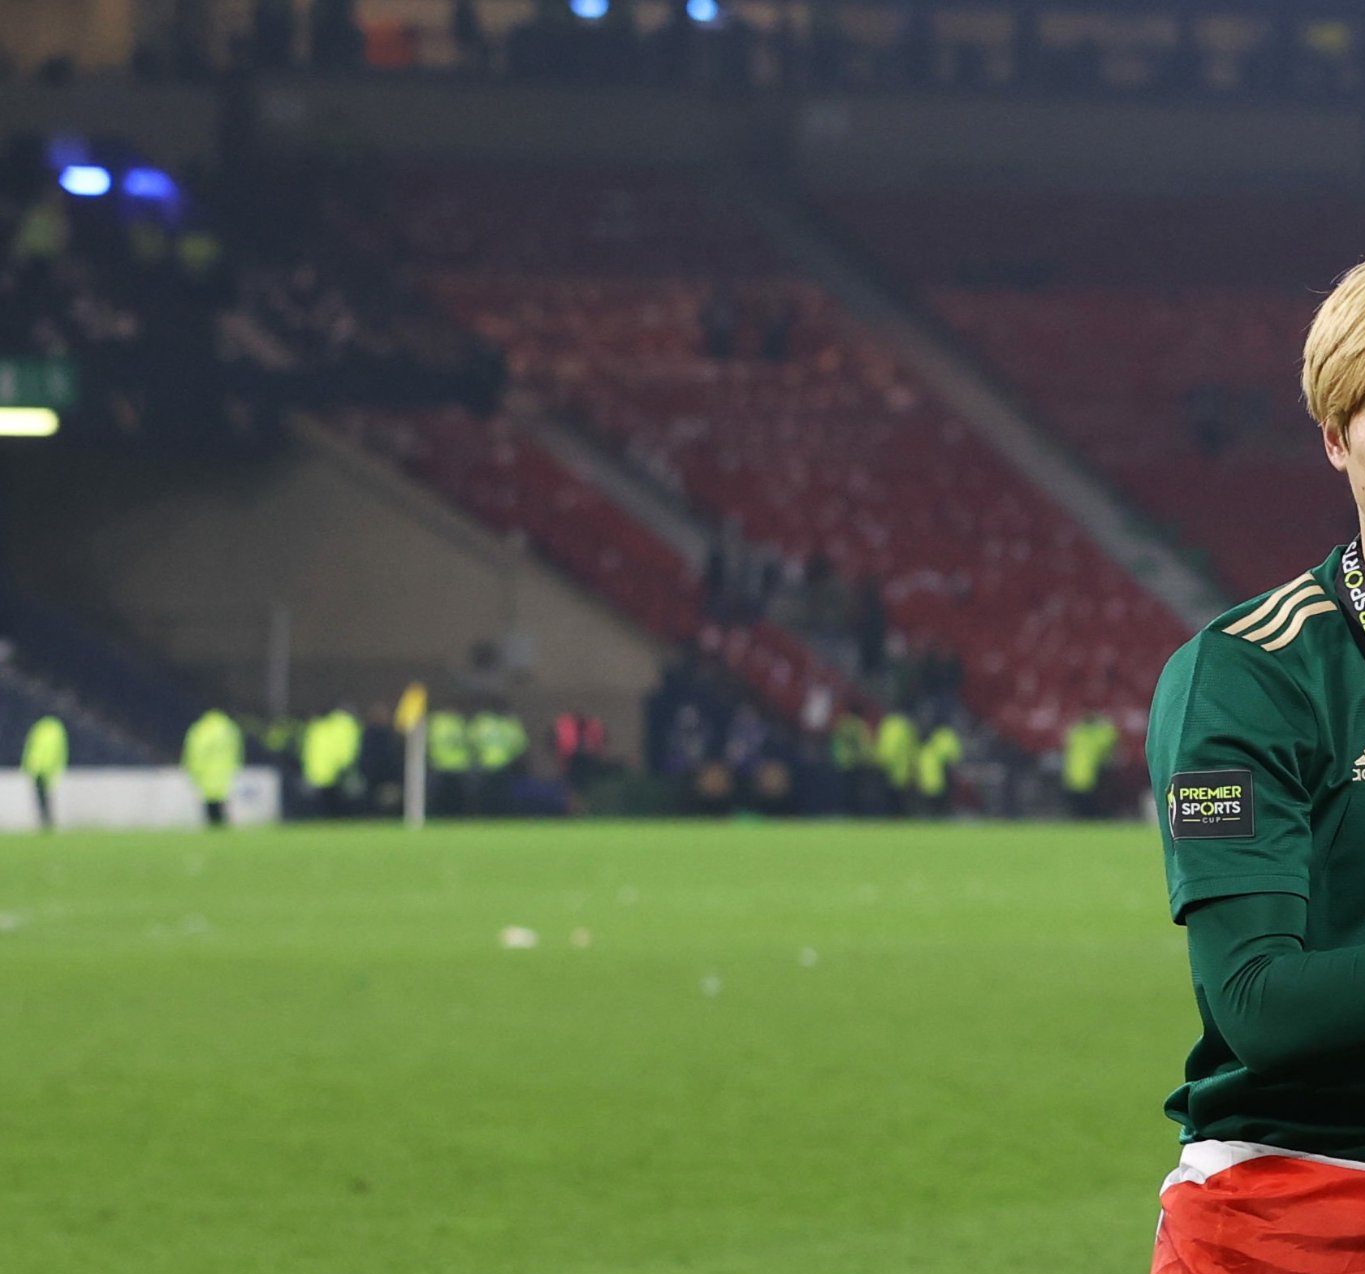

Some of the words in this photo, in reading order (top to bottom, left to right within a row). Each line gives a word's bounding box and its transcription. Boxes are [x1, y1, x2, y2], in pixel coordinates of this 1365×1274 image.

[1179, 785, 1242, 801] PREMIER
[1181, 801, 1241, 816] SPORTS
[1202, 816, 1221, 824] CUP
